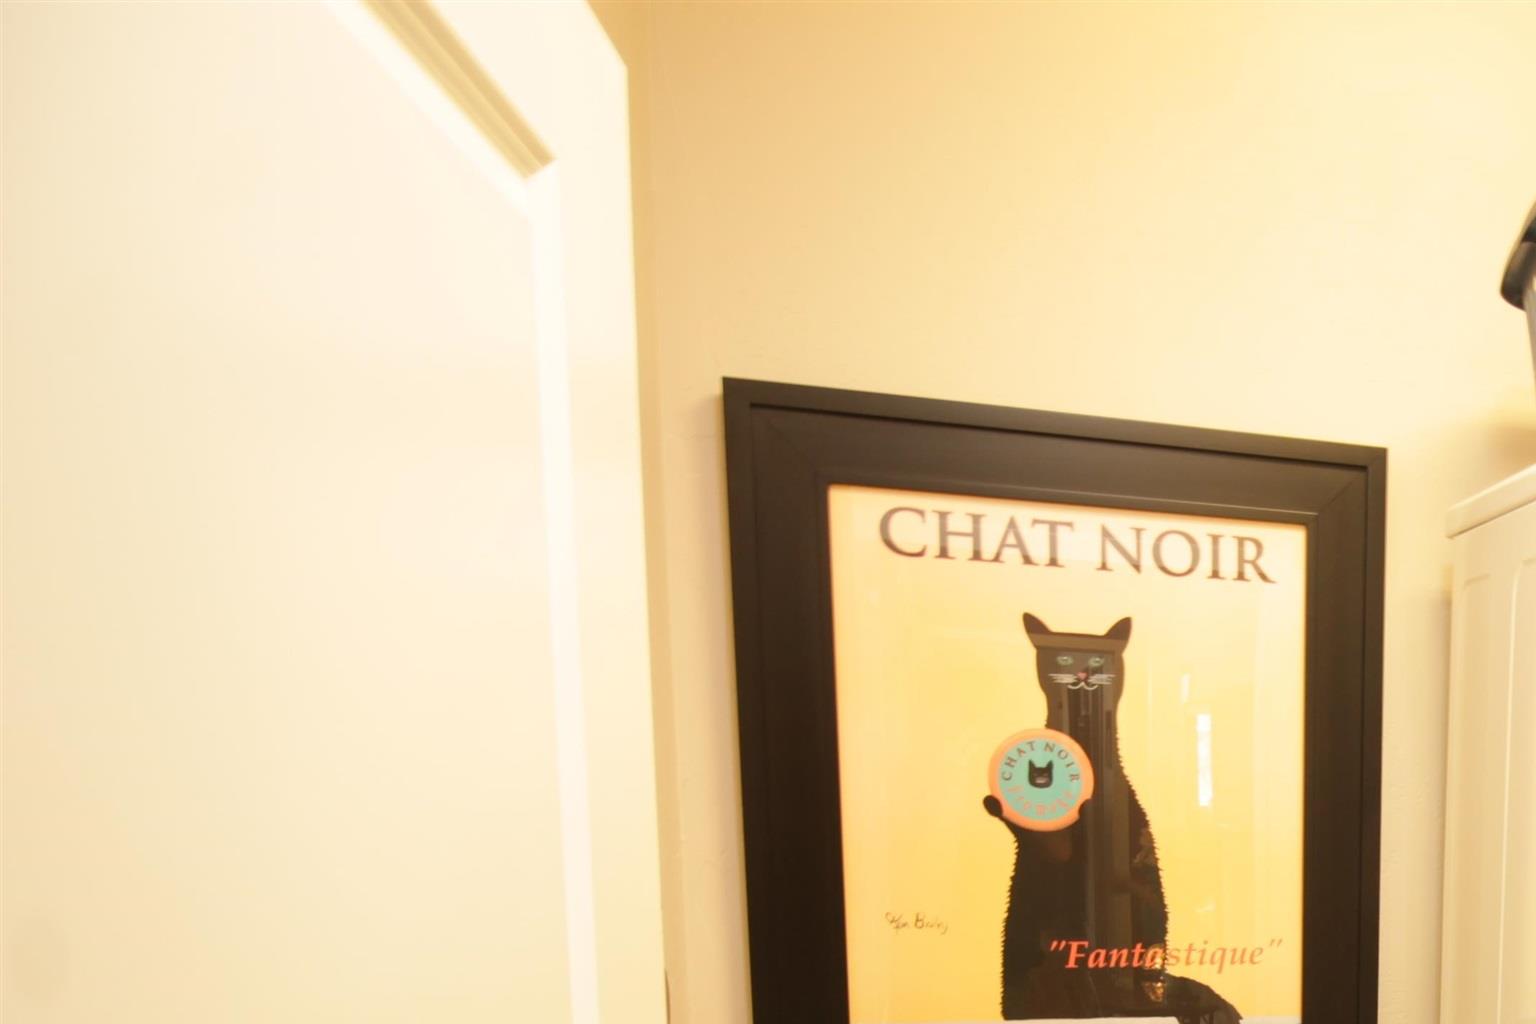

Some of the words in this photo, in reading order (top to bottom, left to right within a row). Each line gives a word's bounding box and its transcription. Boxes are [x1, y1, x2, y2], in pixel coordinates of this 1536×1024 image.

[879, 507, 1075, 568] CHAT
[1095, 524, 1278, 584] NOIR
[1001, 741, 1036, 781] CHAT
[1043, 742, 1080, 782] NOIR
[1051, 938, 1282, 974] "Fantastique"
